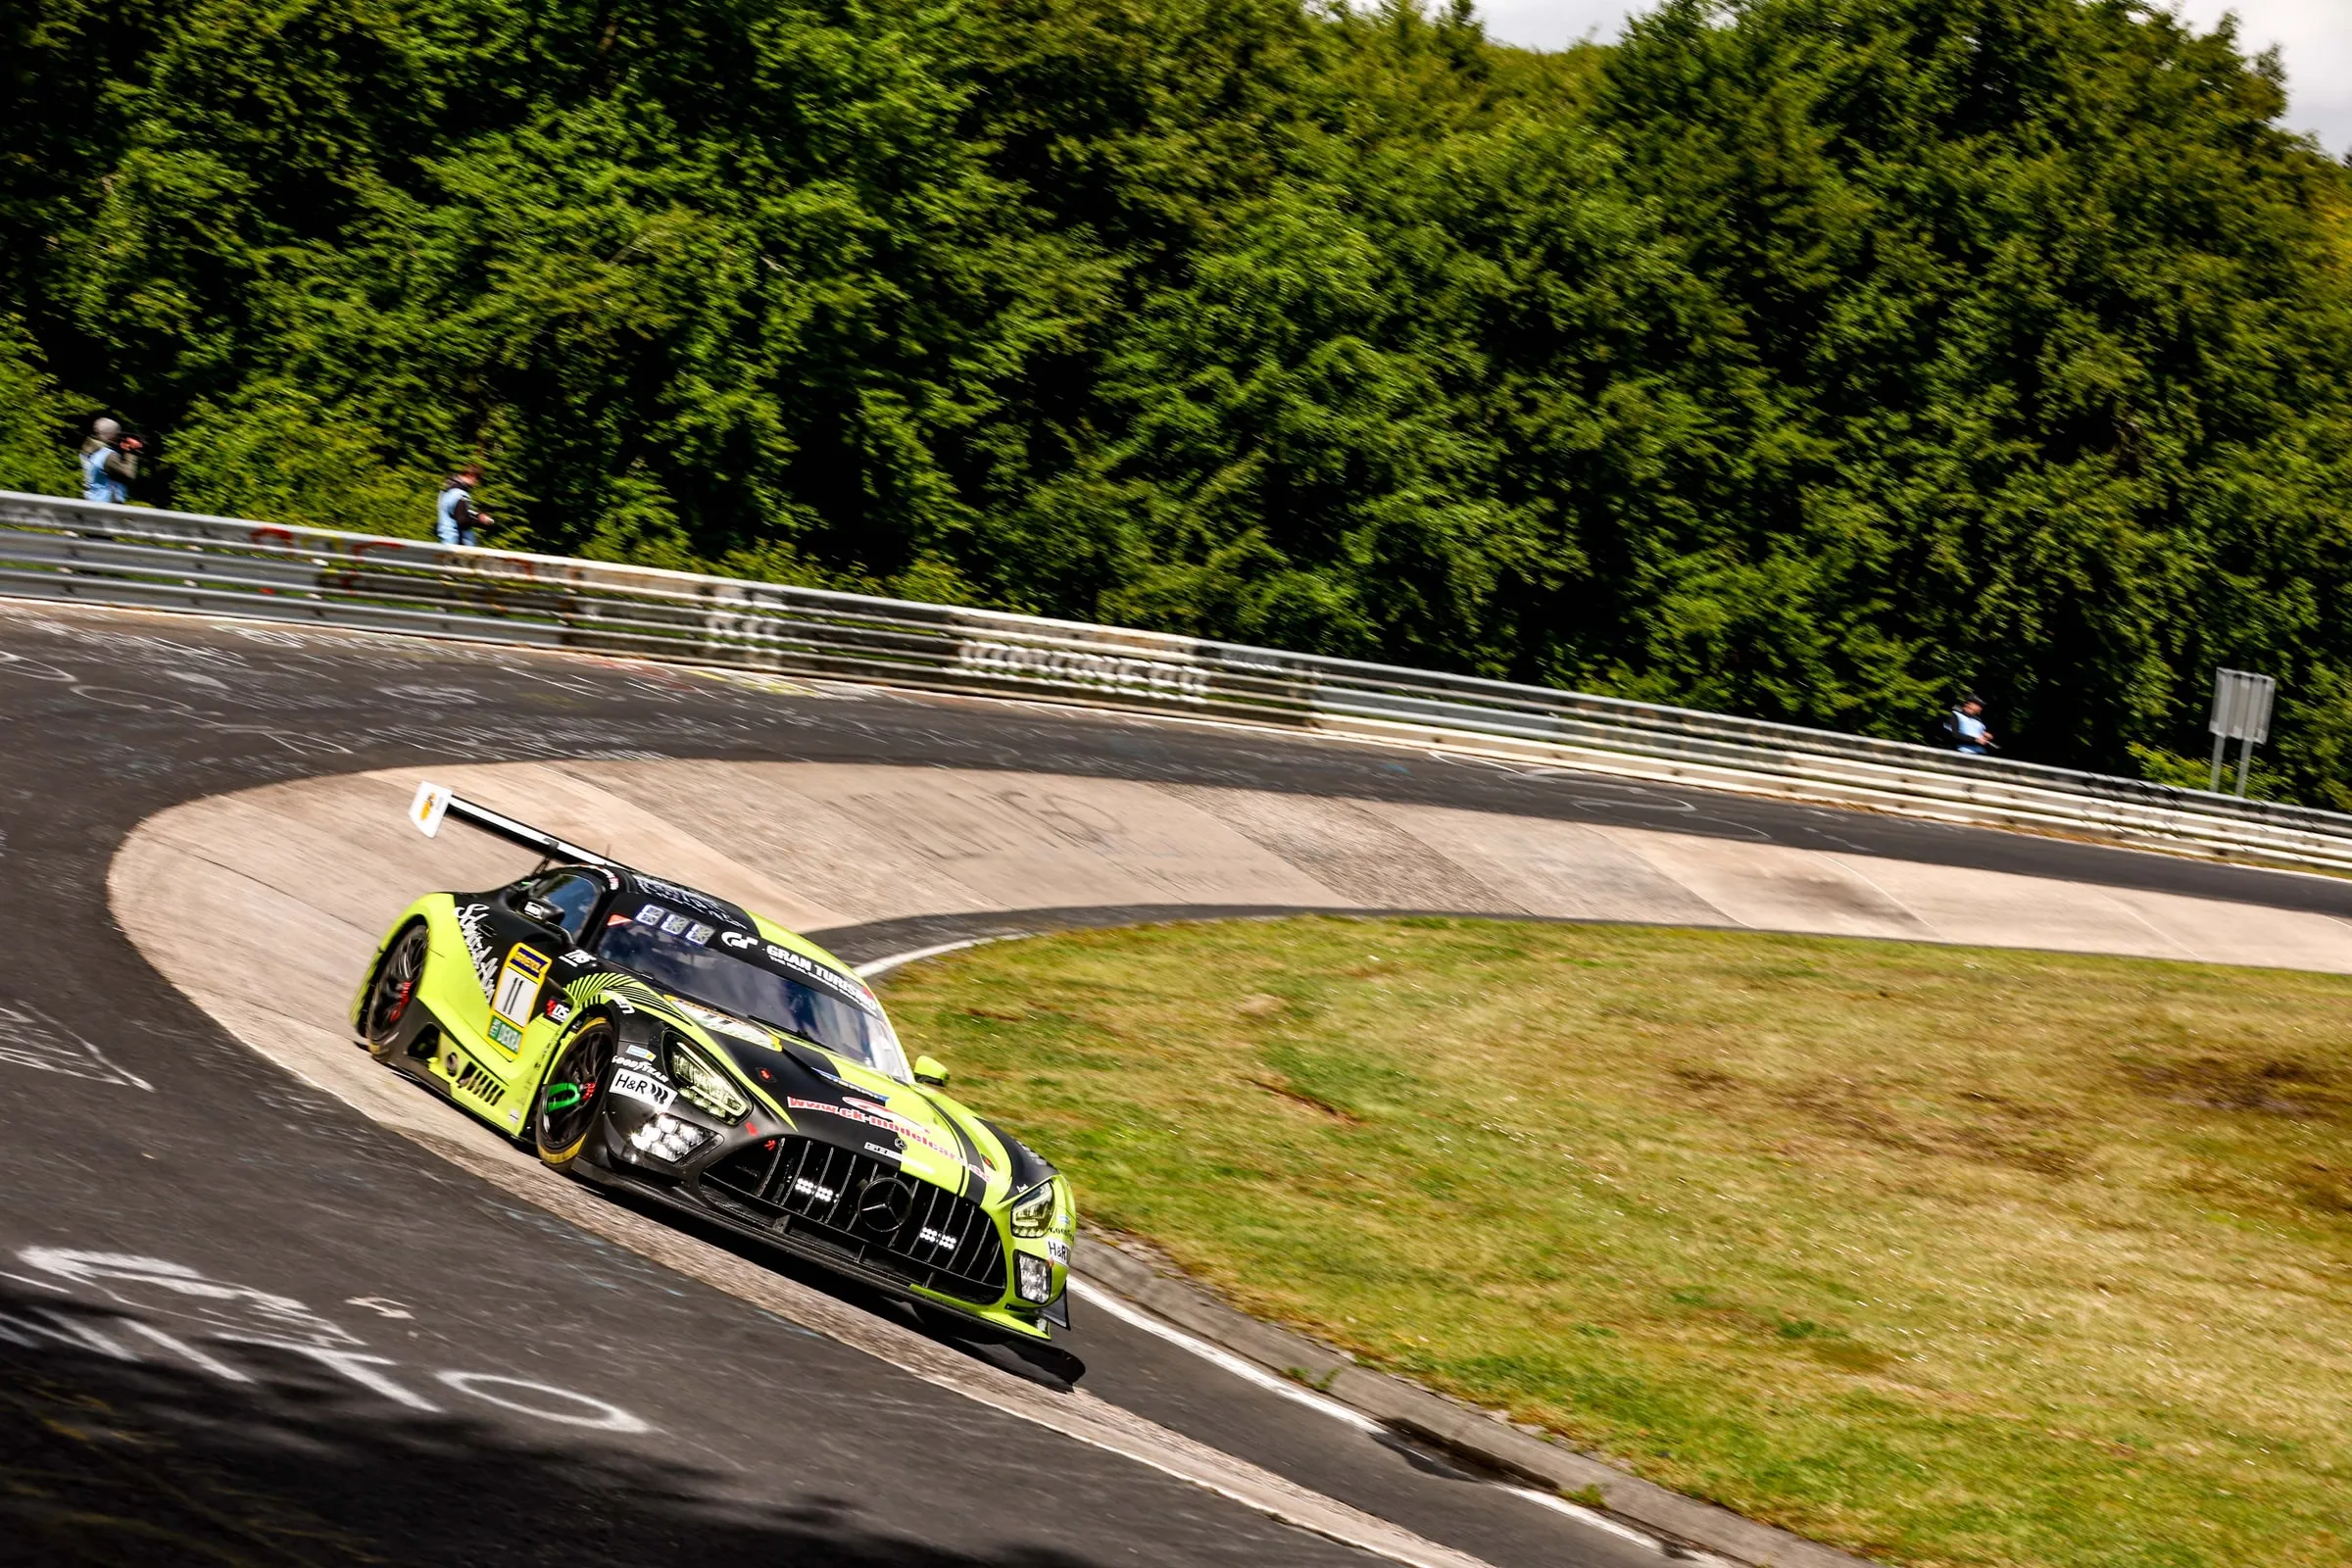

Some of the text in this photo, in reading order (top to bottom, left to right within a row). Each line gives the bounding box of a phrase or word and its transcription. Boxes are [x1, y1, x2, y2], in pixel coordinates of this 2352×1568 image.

[766, 944, 879, 1010] GRAN TURISMO
[503, 977, 524, 1015] 11
[612, 1054, 669, 1084] GOODYEAR
[614, 1073, 649, 1095] H&R
[1048, 1241, 1068, 1261] H&R
